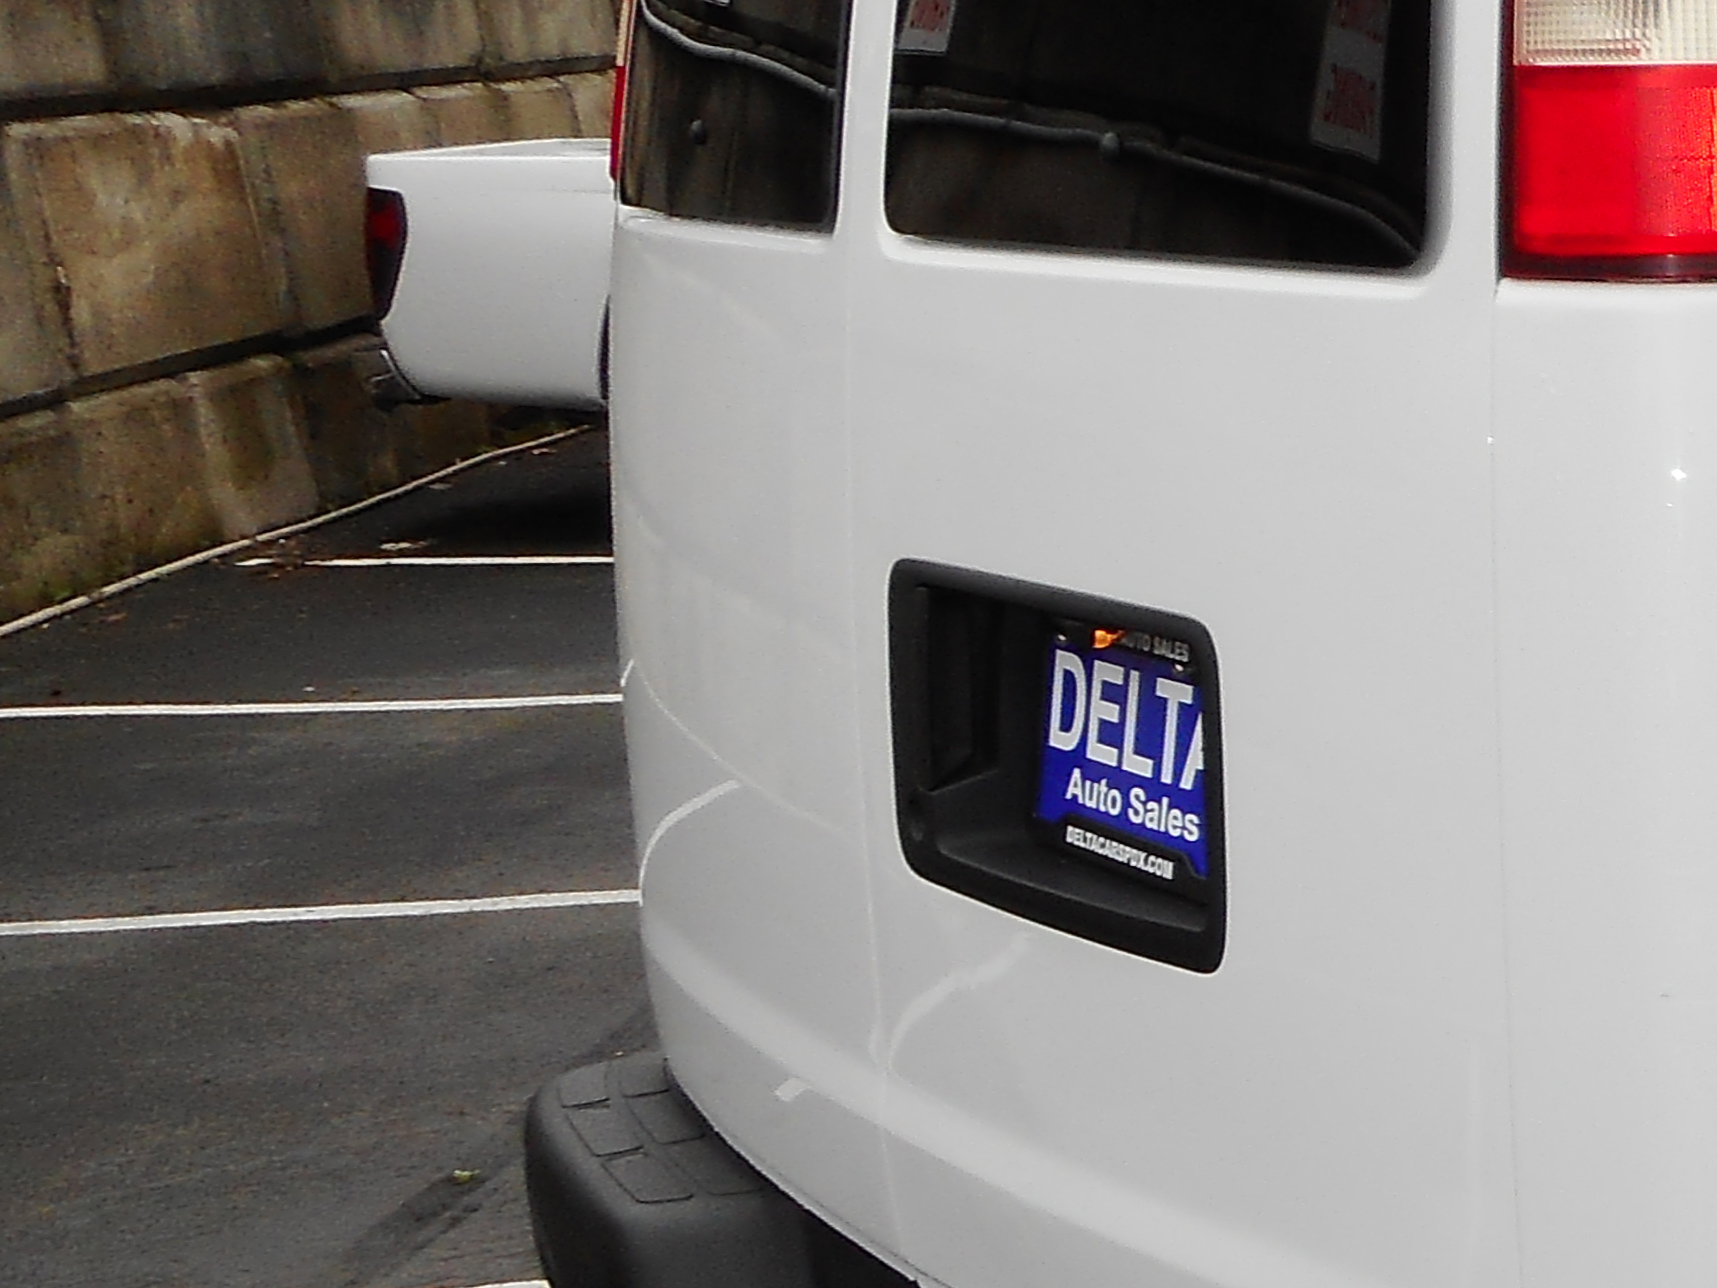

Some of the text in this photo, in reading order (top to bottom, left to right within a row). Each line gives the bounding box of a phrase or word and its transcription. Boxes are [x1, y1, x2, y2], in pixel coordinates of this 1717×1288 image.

[1153, 636, 1190, 663] SALES
[1065, 767, 1200, 842] Auto Sales
